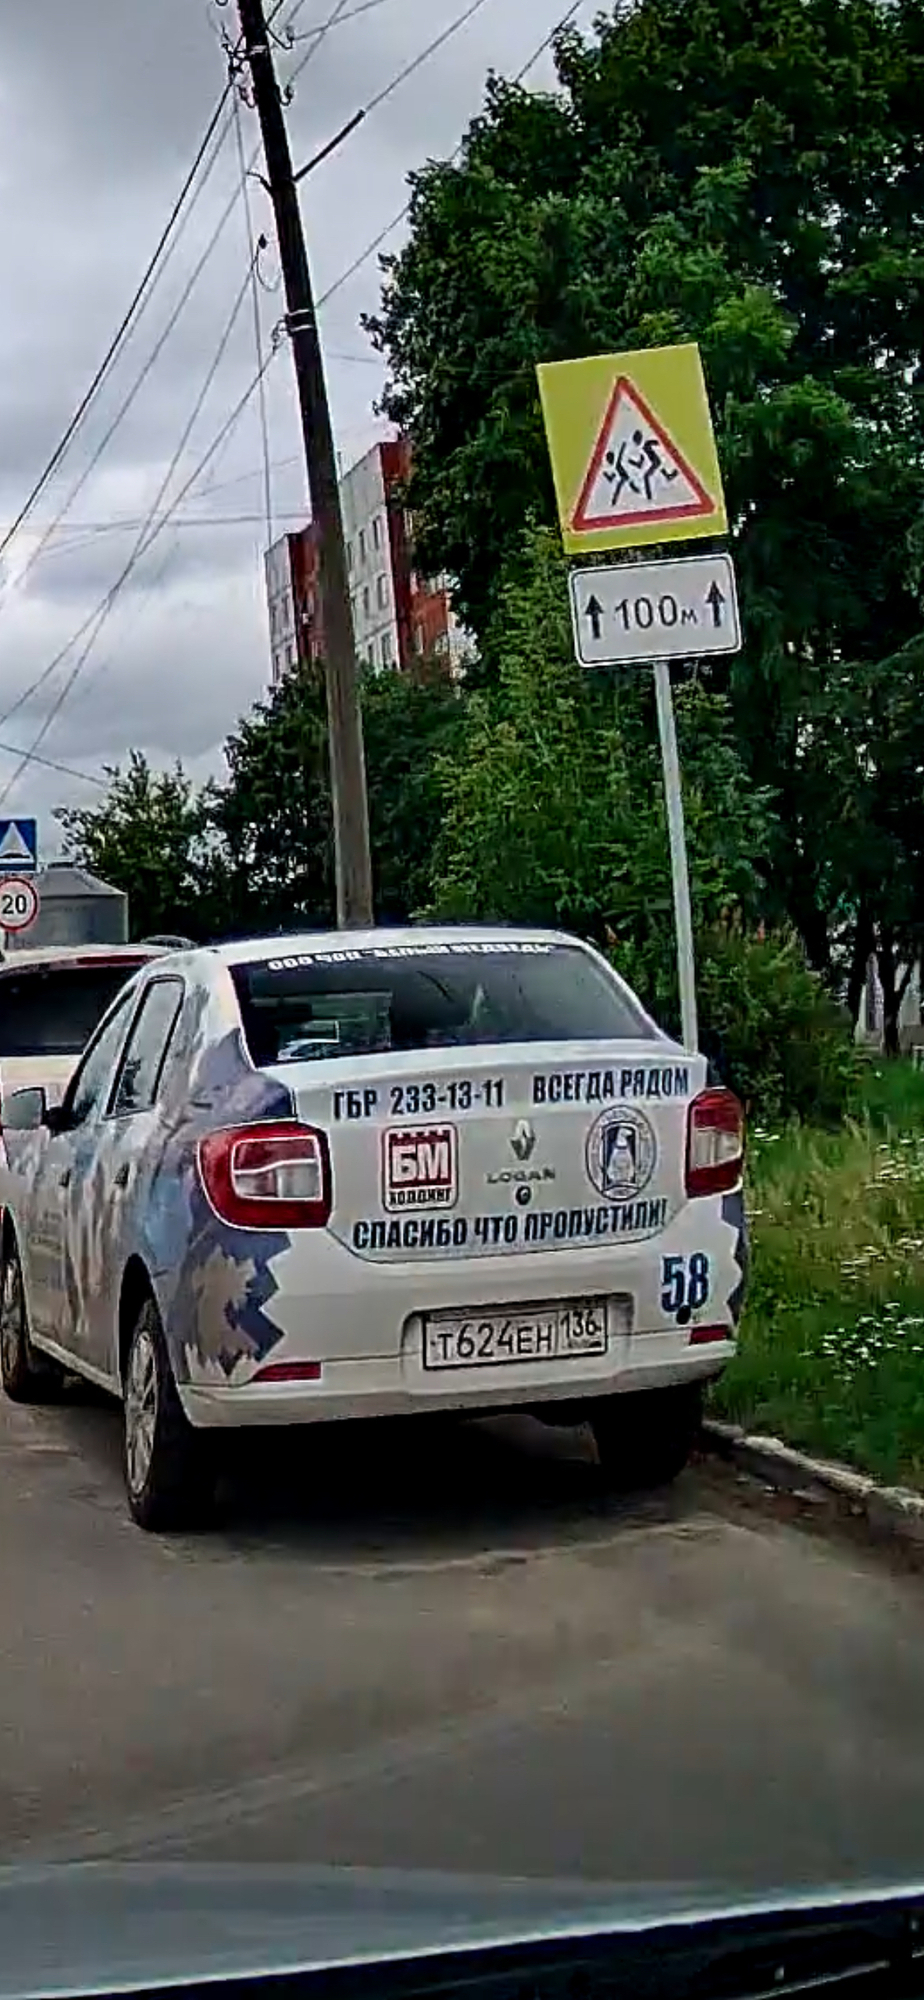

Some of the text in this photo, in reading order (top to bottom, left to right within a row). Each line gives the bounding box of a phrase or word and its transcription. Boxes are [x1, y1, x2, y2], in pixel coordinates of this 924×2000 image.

[2, 894, 27, 914] 20
[334, 1079, 504, 1120] ГБР 233-13-11
[533, 1067, 689, 1104] ВСЕГДА РЯДОМ
[392, 1141, 451, 1183] БМ
[486, 1168, 556, 1184] LOGAN
[353, 1199, 668, 1250] СПАСИБО ЧТО ПРОПУСТИЛИ!
[661, 1253, 709, 1313] 58
[560, 1308, 599, 1340] 136
